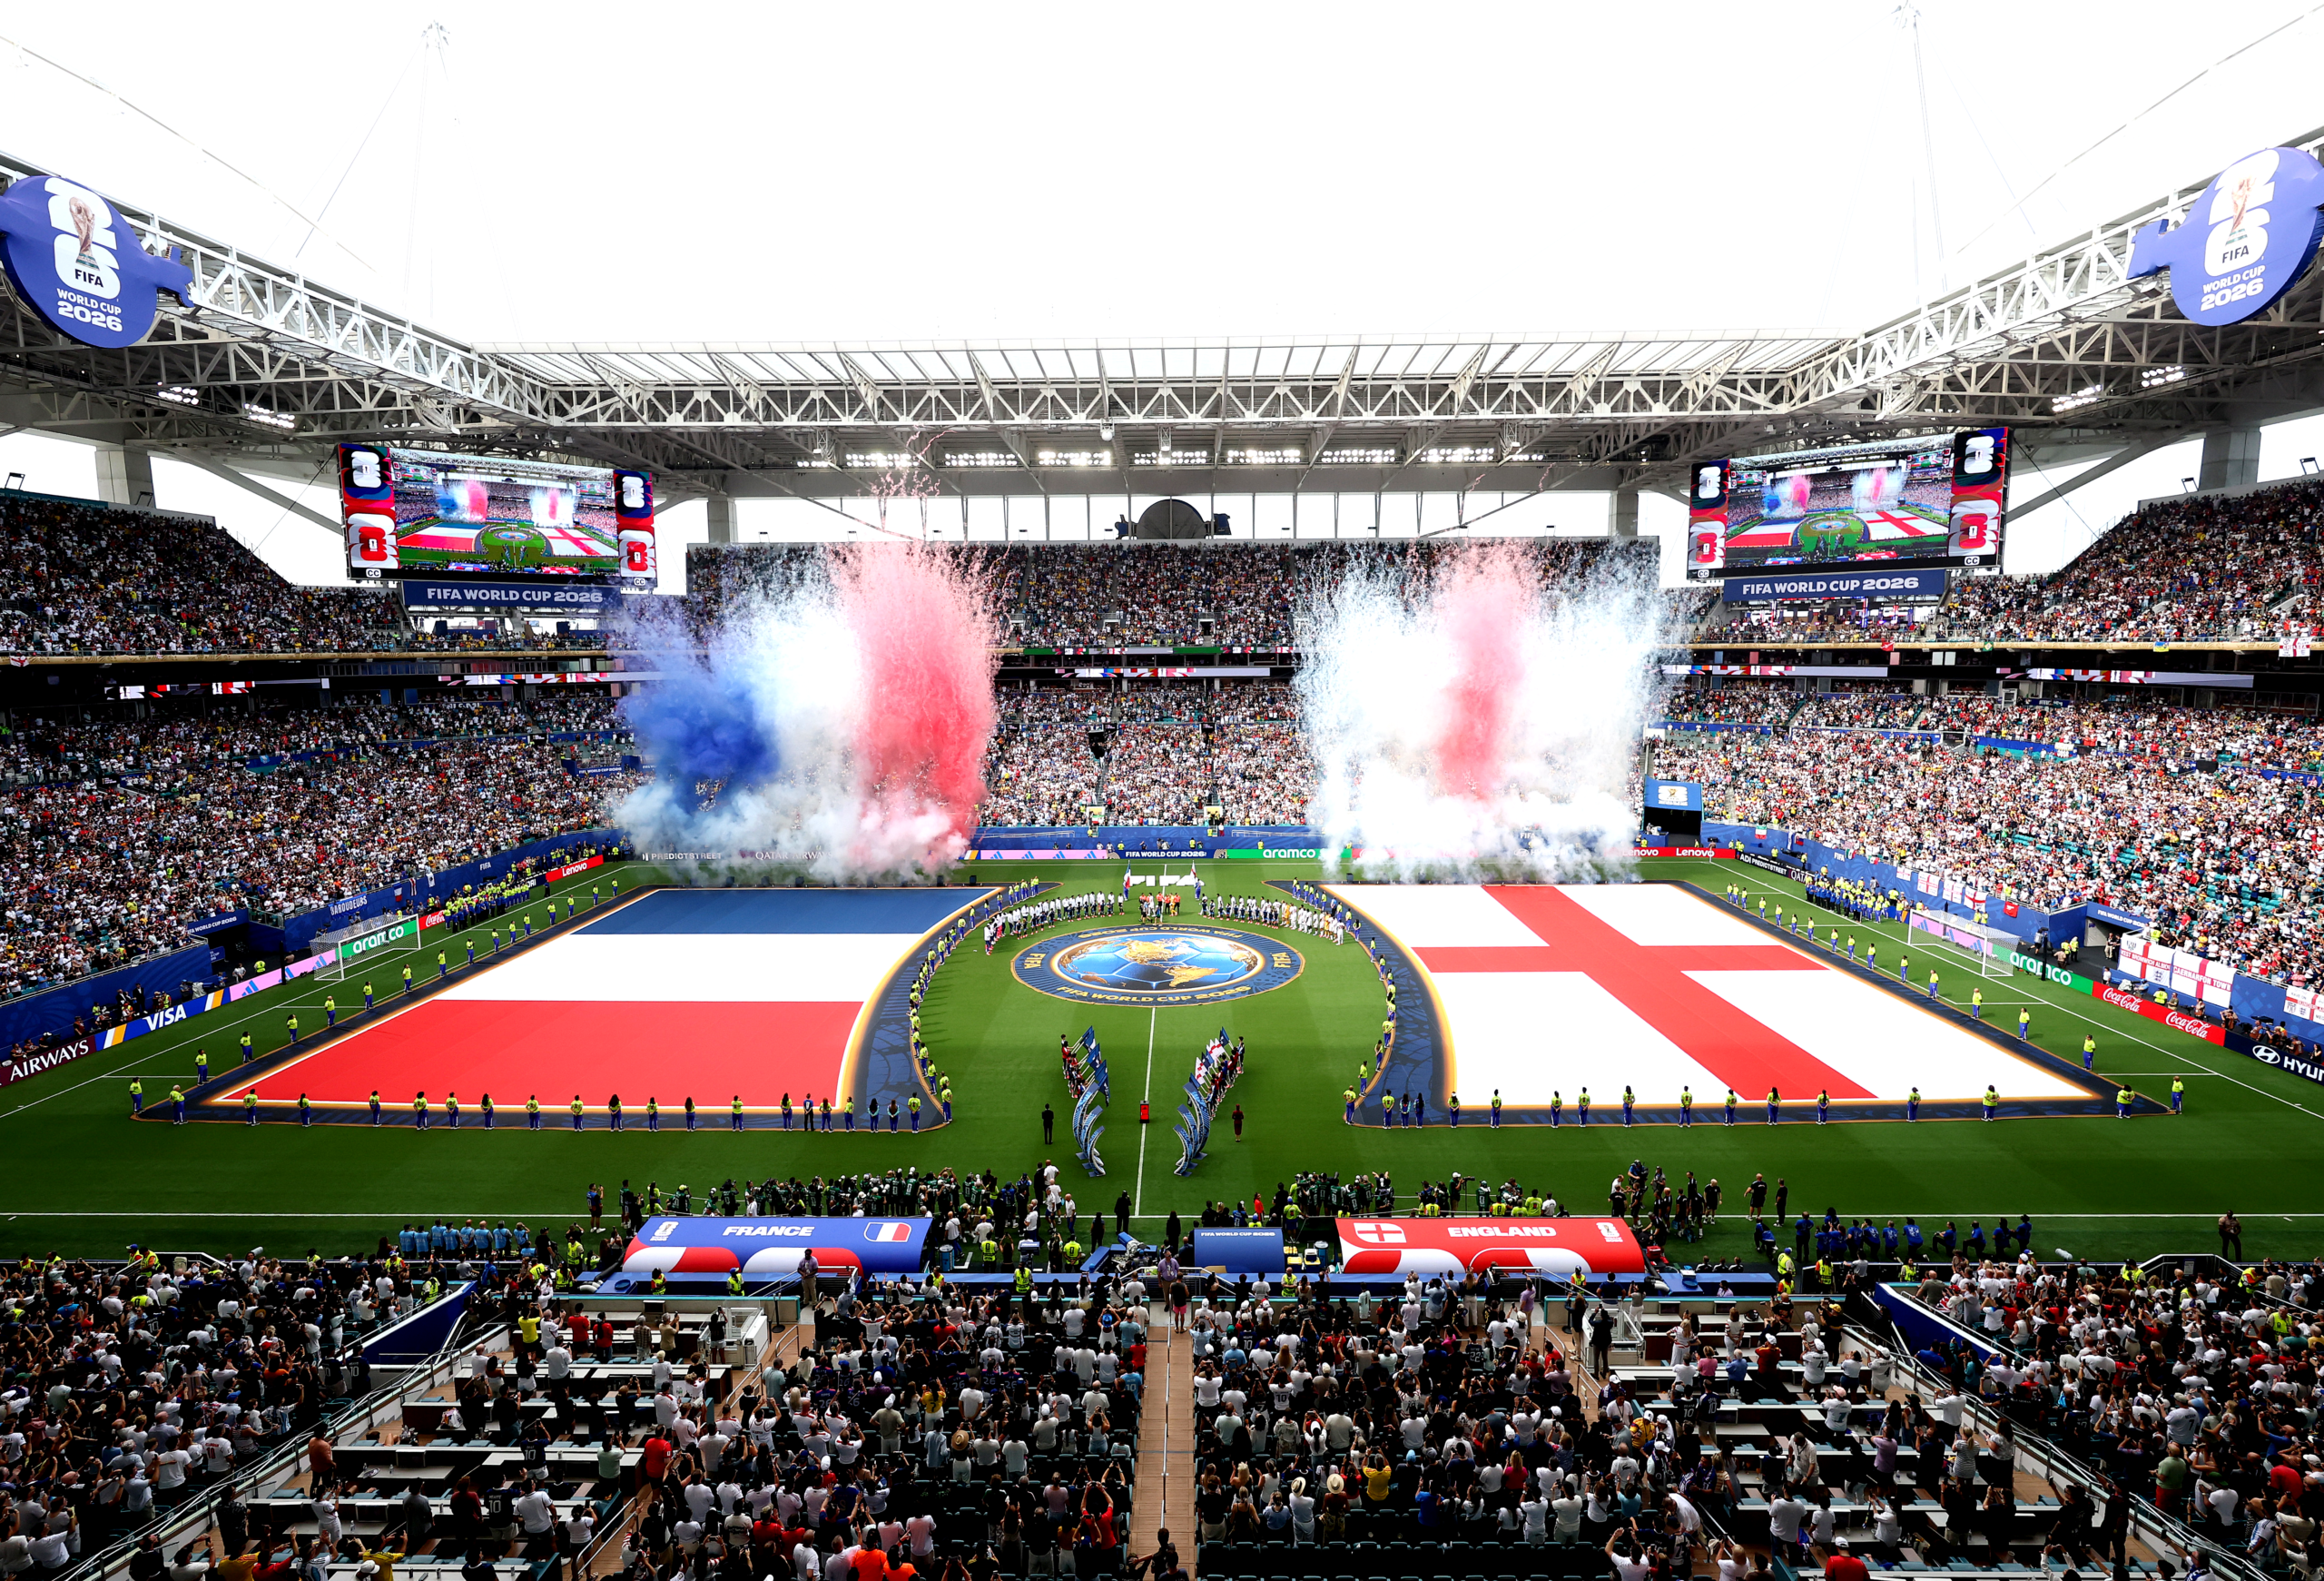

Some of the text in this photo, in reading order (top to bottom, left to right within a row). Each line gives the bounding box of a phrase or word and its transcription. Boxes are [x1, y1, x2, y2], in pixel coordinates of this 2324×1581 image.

[2221, 245, 2250, 264] FIFA
[74, 268, 104, 288] FIFA
[2202, 264, 2266, 294] WORLD CUP
[2200, 278, 2264, 311] 2026
[56, 288, 123, 315] WORLD CUP
[57, 300, 123, 332] 2026
[1965, 557, 1979, 565] CC
[367, 568, 380, 578] CC
[1742, 577, 1919, 595] FIFA WORLD CUP 2026
[427, 588, 603, 603] FIFA WORLD CUP 2026
[755, 852, 789, 860] QATAR
[1263, 848, 1316, 858] aramco
[1676, 848, 1715, 856] Lenovo
[1834, 852, 1845, 862] FIFA
[479, 862, 491, 871] FIFA
[562, 863, 587, 877] Lenovo
[1752, 859, 1787, 875] PREDICTSTREET
[1791, 871, 1806, 883] QATA
[195, 924, 212, 933] WORLD
[1024, 953, 1046, 969] FIFA
[1273, 952, 1291, 968] FIFA
[2132, 952, 2155, 966] BROMWICH
[2009, 951, 2073, 986] aramco
[2173, 965, 2231, 992] CAERNARFON TOWN
[1057, 986, 1088, 997] FIFA
[1091, 993, 1154, 1003] WORLD
[1194, 985, 1252, 1000] 2026
[2102, 987, 2142, 1013] Coca-Cola
[143, 1003, 187, 1032] VISA
[2165, 1011, 2211, 1040] Coca-Cola
[9, 1039, 89, 1082] AIRWAYS
[722, 1226, 815, 1236] FRANCE
[1447, 1226, 1557, 1237] ENGLAND
[1244, 1339, 1253, 1350] 10
[1817, 1360, 1824, 1370] 4
[350, 1366, 359, 1377] 10
[951, 1380, 965, 1390] 26
[983, 1377, 996, 1385] 26
[930, 1402, 936, 1412] 7
[1683, 1408, 1694, 1418] 10
[2189, 1419, 2195, 1431] 7
[206, 1448, 216, 1458] 10
[525, 1449, 536, 1461] 10
[489, 1500, 501, 1513] 10
